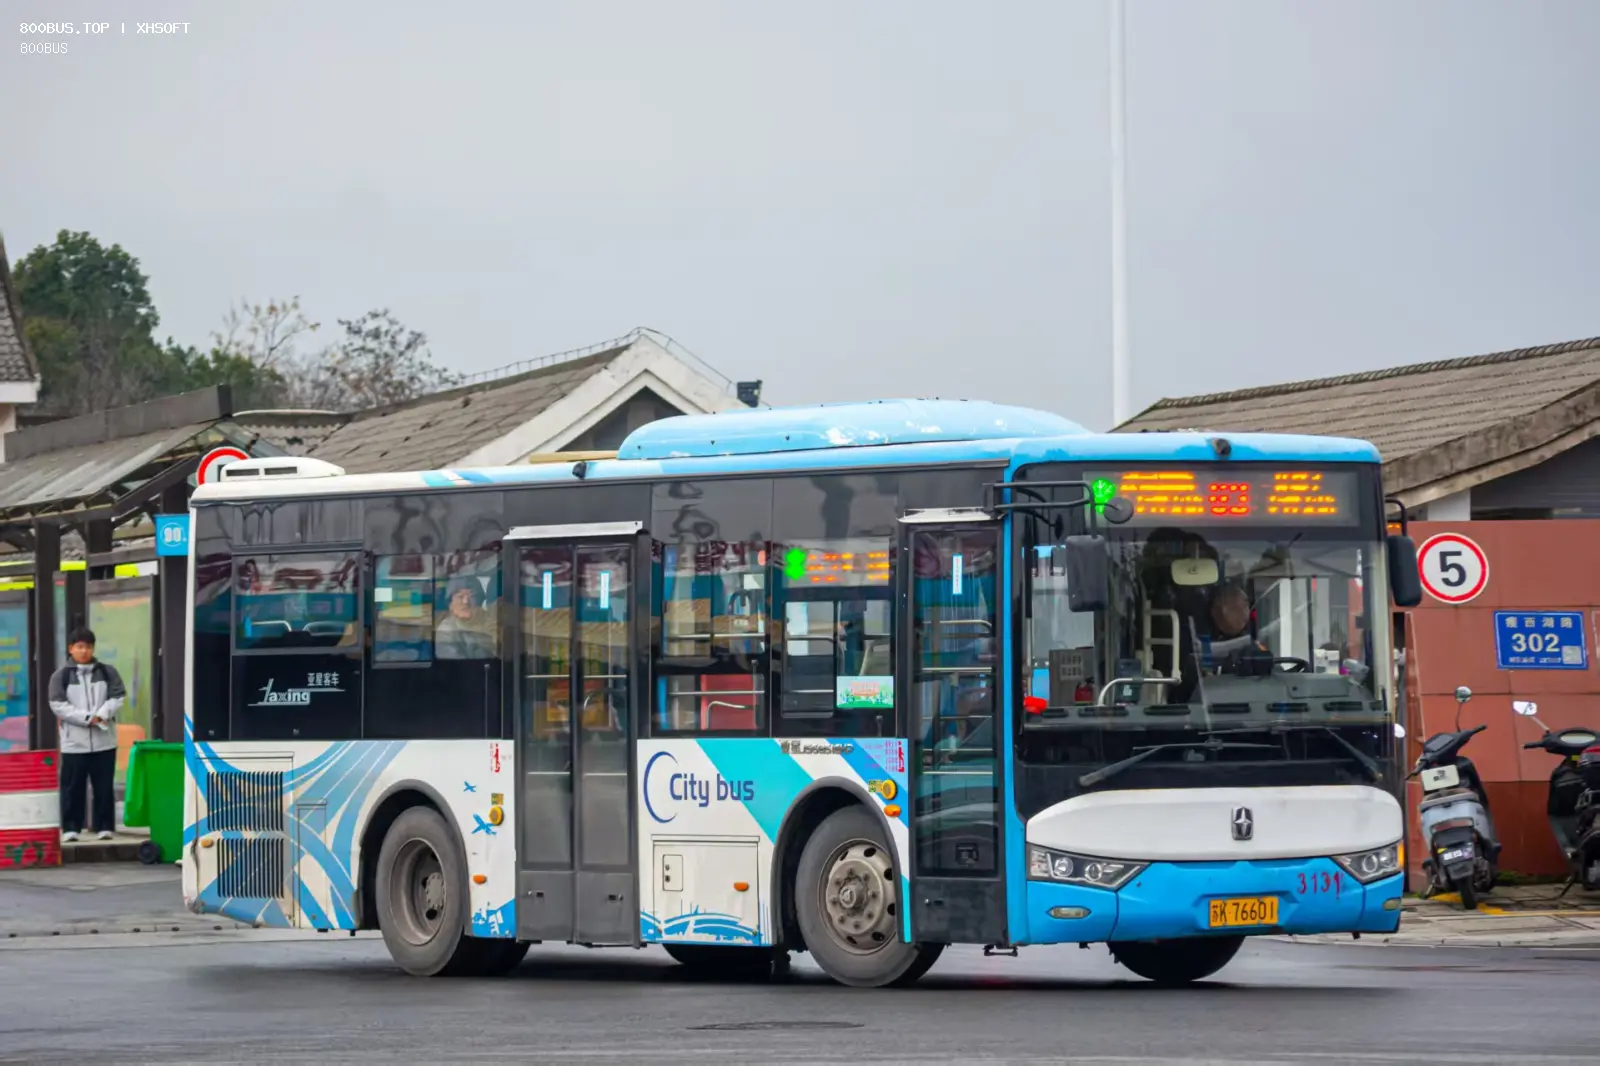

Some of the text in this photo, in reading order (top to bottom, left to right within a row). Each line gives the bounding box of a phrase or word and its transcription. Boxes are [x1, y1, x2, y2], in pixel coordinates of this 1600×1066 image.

[1439, 550, 1467, 588] 5
[1511, 633, 1560, 653] 302
[307, 672, 340, 686] 亚星客车
[669, 773, 755, 808] City bus
[1297, 871, 1341, 899] 3131
